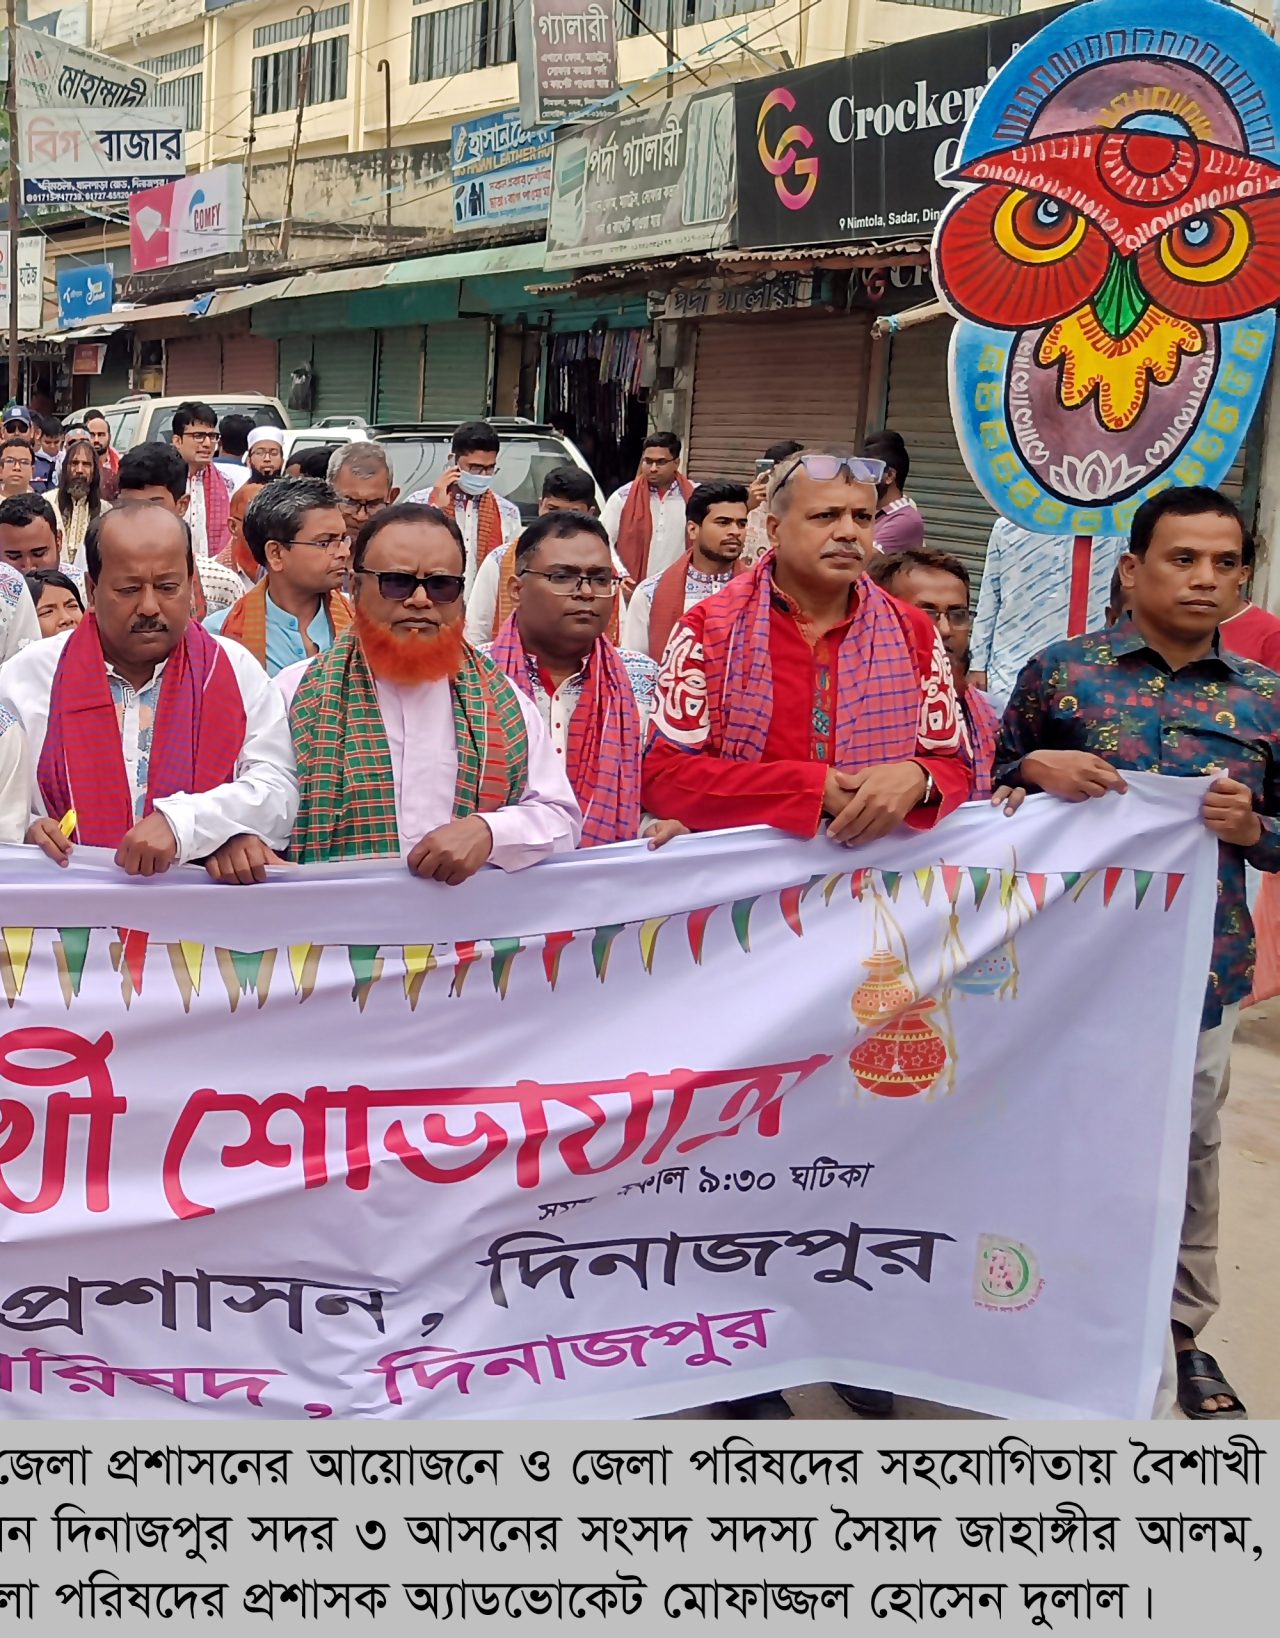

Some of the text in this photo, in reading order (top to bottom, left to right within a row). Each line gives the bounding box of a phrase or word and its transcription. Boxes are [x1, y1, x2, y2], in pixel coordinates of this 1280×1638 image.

[539, 3, 608, 45] গ্যালারী
[27, 116, 182, 163] বিগ বাজার
[589, 130, 619, 184] পর্দা
[623, 115, 683, 177] গ্যালারী
[194, 203, 221, 231] COMFY
[847, 214, 886, 229] Nimtola,
[888, 210, 920, 225] Sadar,
[699, 1165, 776, 1194] ৯:৩০
[790, 1156, 875, 1192] ঘটিকা
[477, 1222, 957, 1308] দিনাজপুর
[364, 1308, 777, 1406] দিনাজপুর
